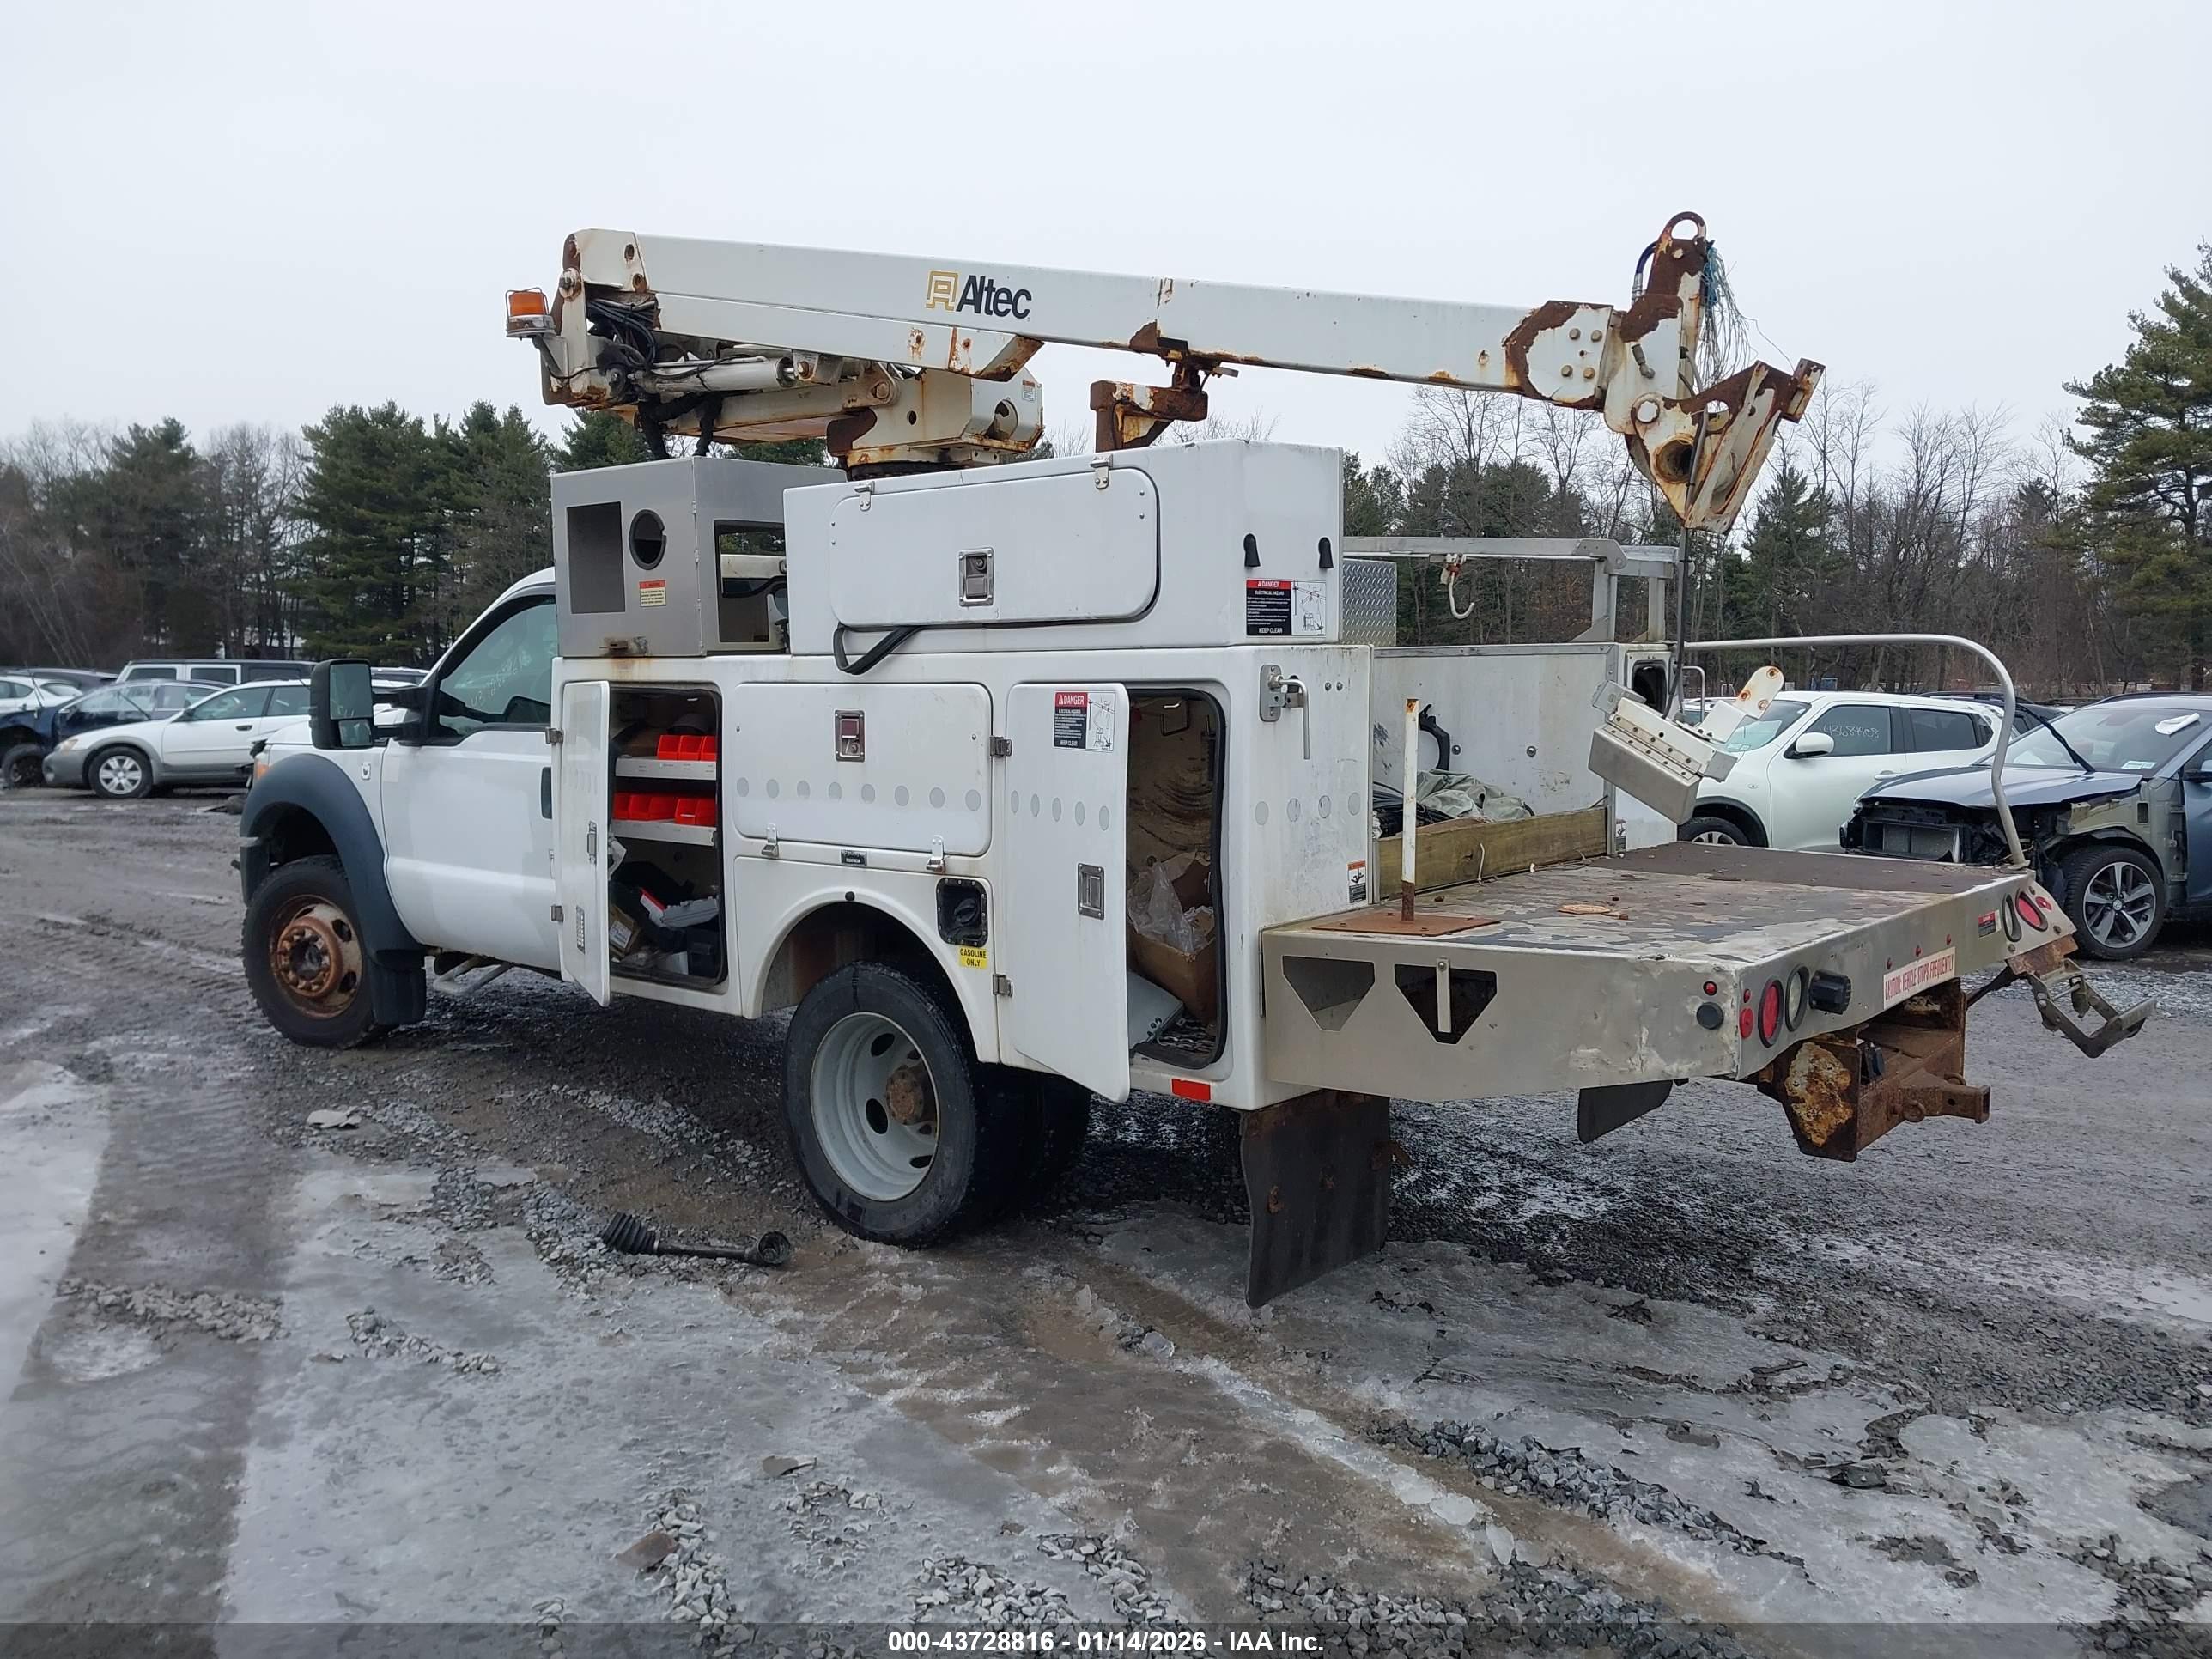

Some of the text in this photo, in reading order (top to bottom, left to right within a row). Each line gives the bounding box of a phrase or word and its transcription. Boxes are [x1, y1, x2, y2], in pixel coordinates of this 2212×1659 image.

[956, 275, 1031, 319] Altec
[1064, 695, 1085, 705] DANGER
[960, 948, 987, 958] GASOLINE
